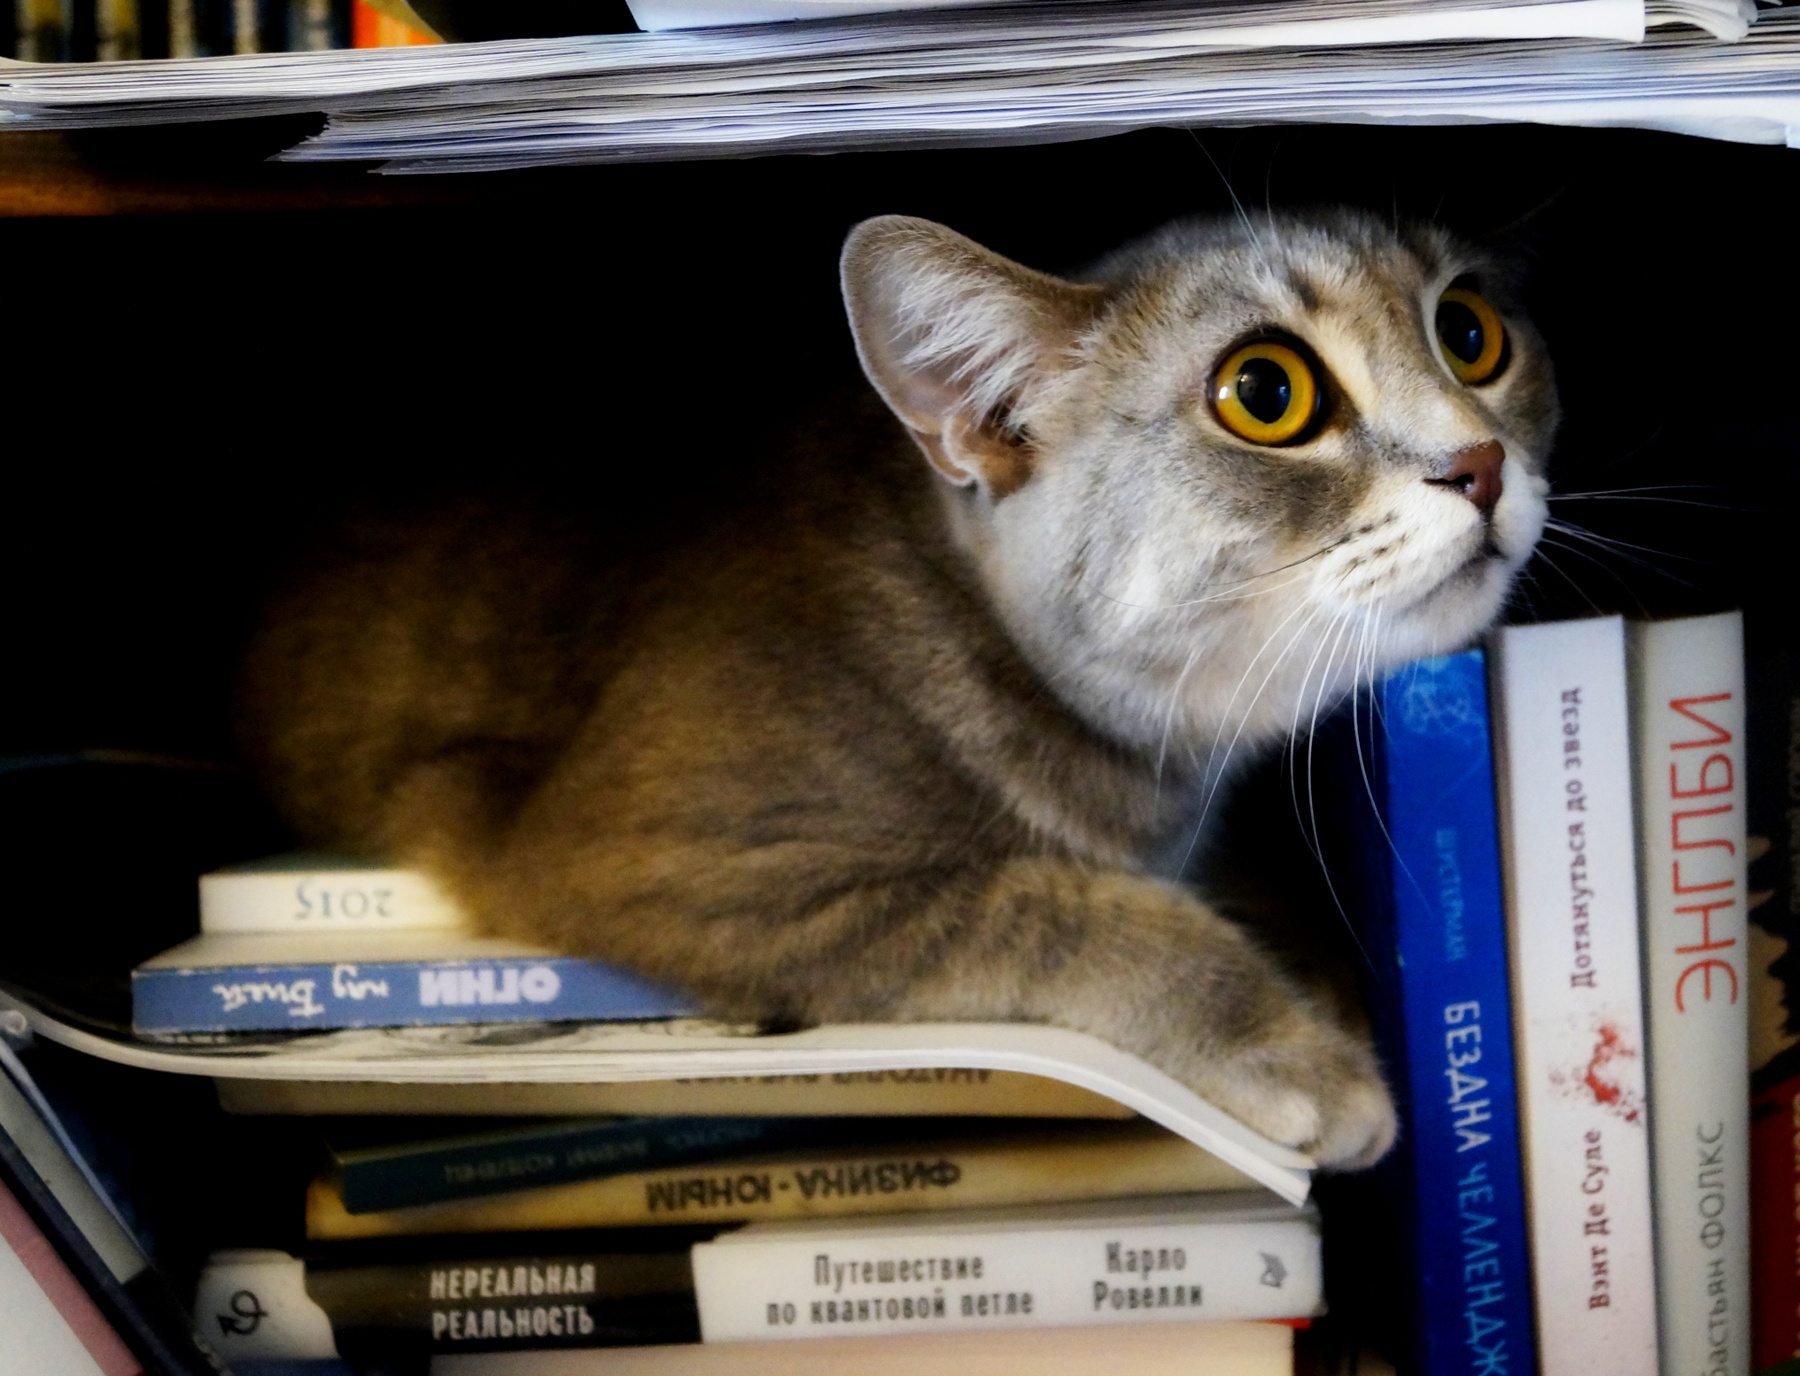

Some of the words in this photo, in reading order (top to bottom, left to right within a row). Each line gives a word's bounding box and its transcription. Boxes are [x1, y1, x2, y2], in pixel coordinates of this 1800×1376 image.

[1561, 687, 1582, 769] звезд
[1565, 779, 1587, 811] до
[1669, 692, 1738, 1013] ЭНГЛБИ
[294, 877, 394, 920] 2015
[1568, 821, 1596, 989] Дотянуться
[212, 979, 325, 1019] Бией
[332, 963, 390, 999] над
[418, 965, 562, 1006] ОГНИ
[1444, 1000, 1493, 1153] БЕЗДНА
[793, 1159, 962, 1201] ФИЗИКА
[1581, 1129, 1610, 1196] Суле
[644, 1172, 772, 1213] ЮНЫМ
[1697, 1121, 1726, 1249] ФОЛКС
[1584, 1203, 1611, 1237] Де
[814, 1253, 985, 1293] Путешествие
[1105, 1241, 1187, 1279] Карло
[429, 1263, 596, 1300] НЕРЕАЛЬНАЯ
[1092, 1281, 1204, 1312] Ровелли
[431, 1304, 596, 1341] РЕАЛЬНОСТЬ
[765, 1301, 797, 1326] по
[810, 1287, 947, 1324] квантовой
[961, 1289, 1034, 1317] петле
